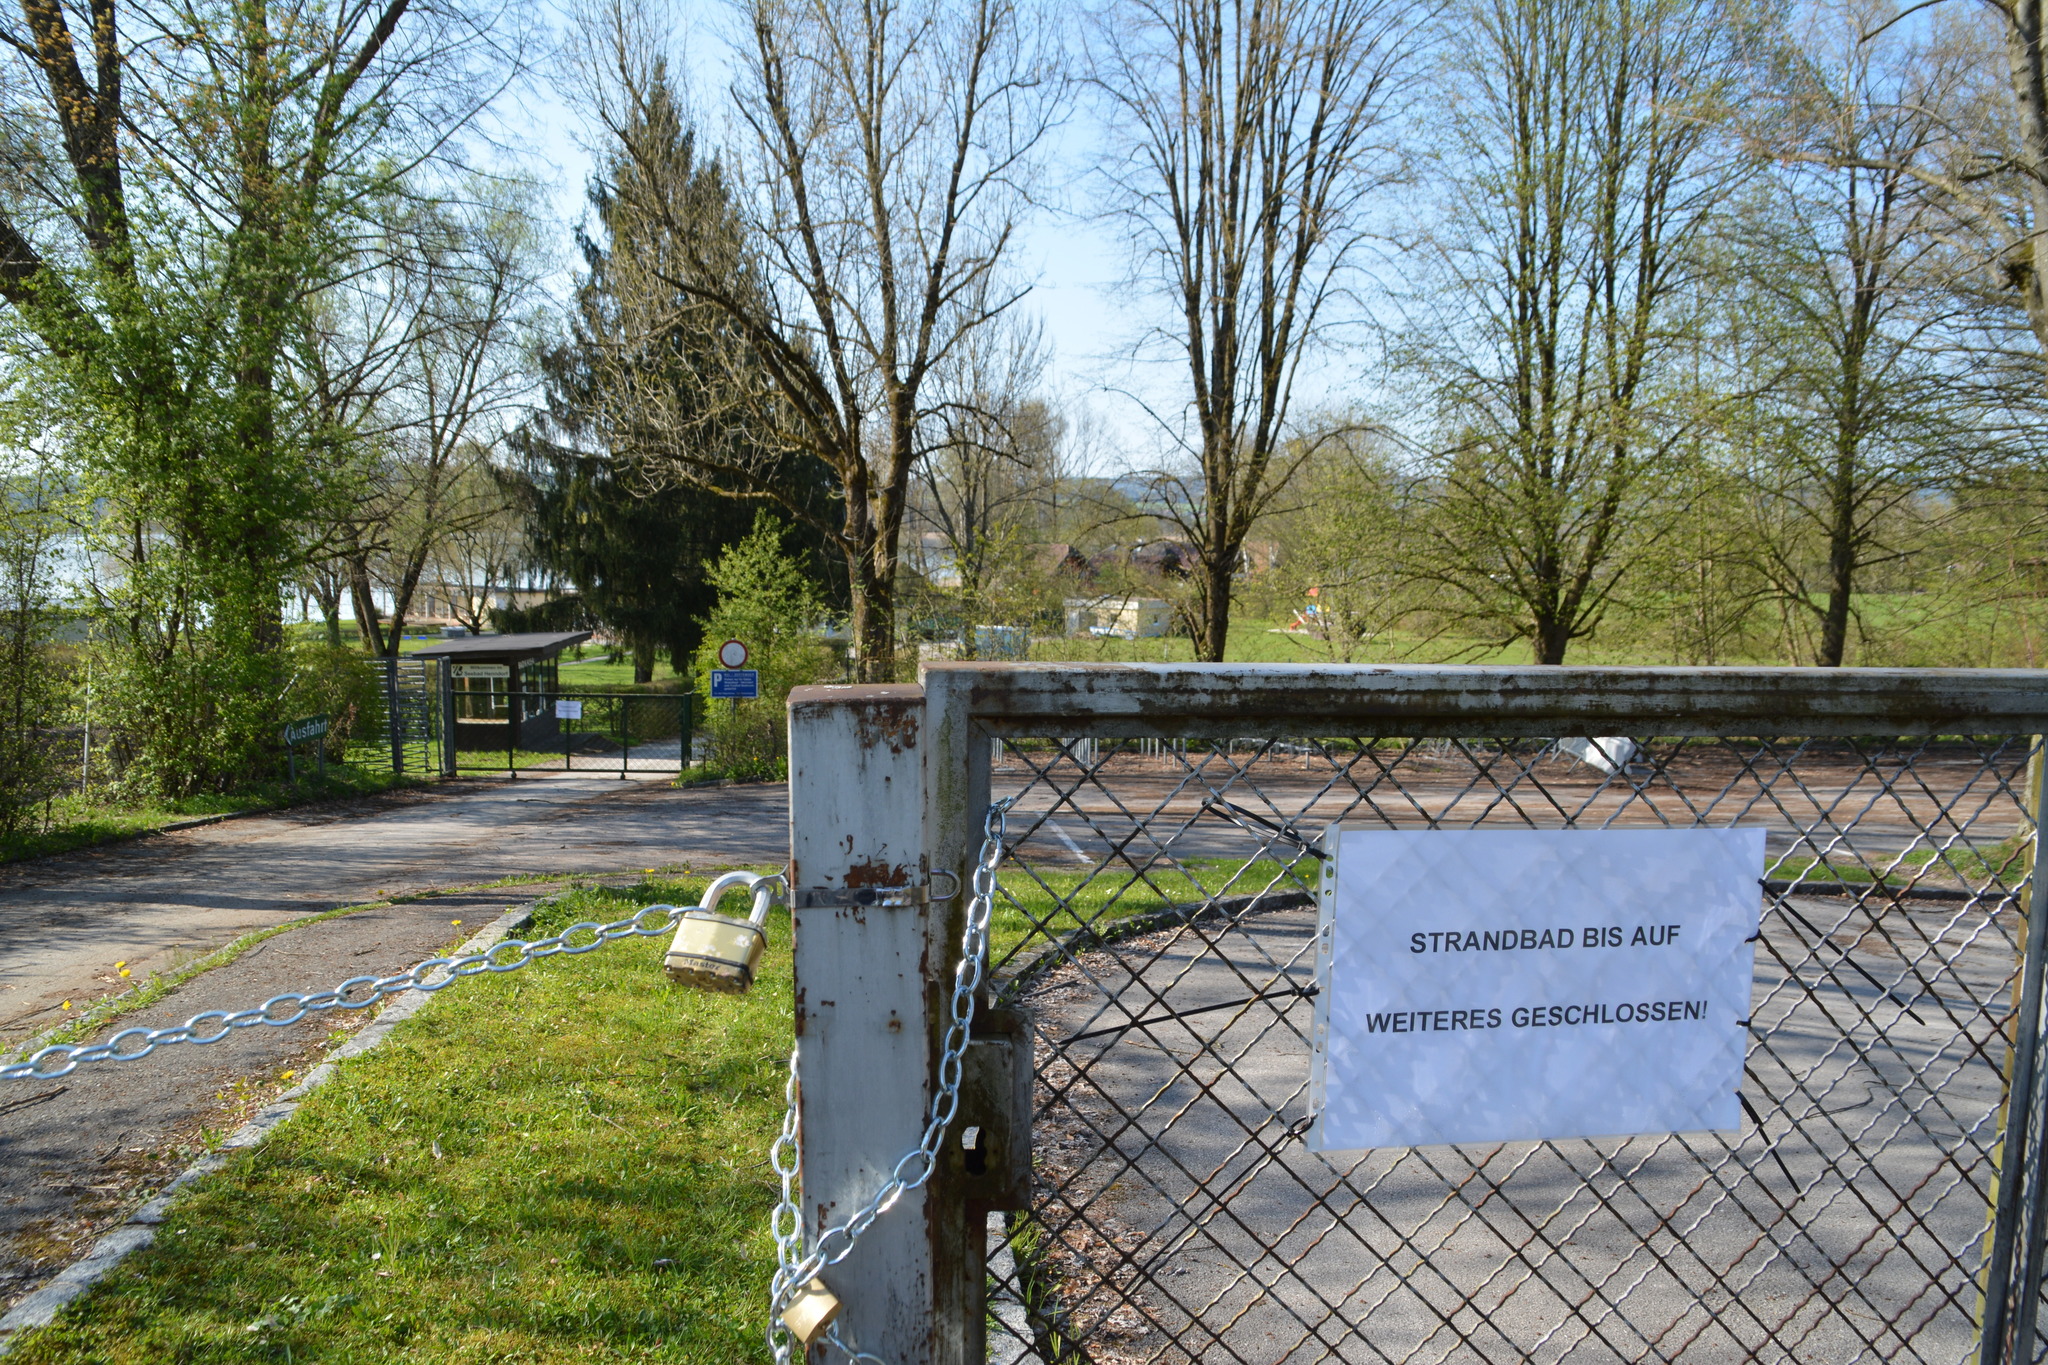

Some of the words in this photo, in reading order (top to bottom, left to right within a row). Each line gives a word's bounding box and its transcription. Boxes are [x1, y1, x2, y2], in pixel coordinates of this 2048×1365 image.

[713, 673, 722, 687] P
[290, 719, 328, 740] Ausfahrt
[1410, 927, 1575, 954] STRANDBAD
[1582, 926, 1623, 949] BIS
[1631, 924, 1681, 947] AUF
[683, 959, 720, 970] Master
[1366, 1008, 1502, 1034] WEITERES
[1511, 1000, 1708, 1029] GESCHLOSSEN!
